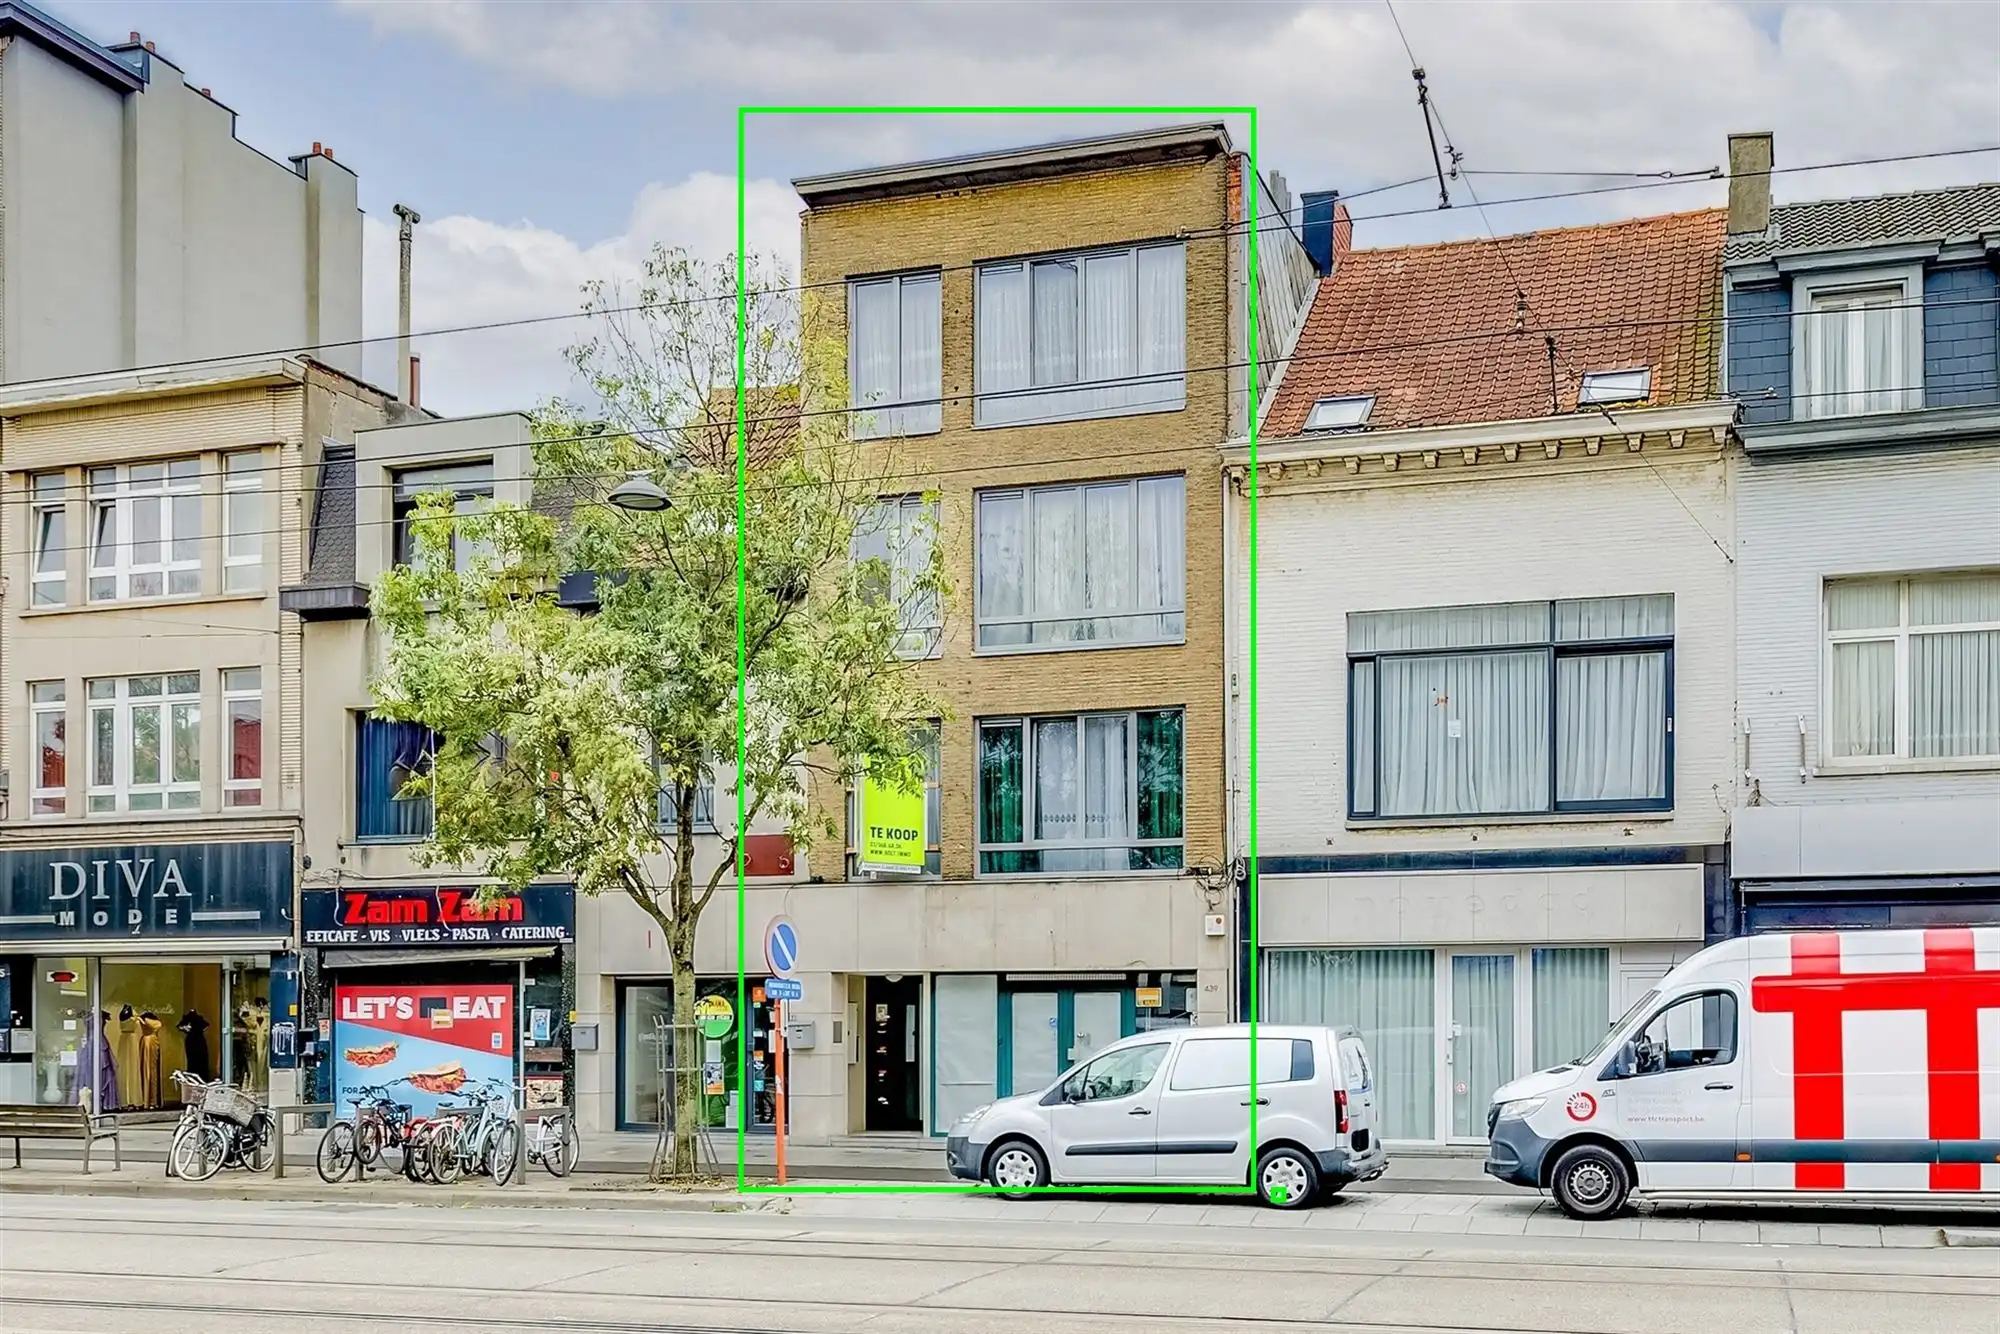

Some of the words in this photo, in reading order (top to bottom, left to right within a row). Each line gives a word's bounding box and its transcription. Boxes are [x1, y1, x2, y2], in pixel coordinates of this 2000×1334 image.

[870, 826, 883, 838] TE
[886, 828, 918, 841] KOOP
[49, 858, 192, 900] DIVA
[344, 892, 428, 923] Zam
[436, 891, 524, 922] Zam
[58, 908, 178, 927] MODE
[306, 930, 358, 942] EETCAFE
[369, 929, 391, 941] VIS
[452, 928, 490, 940] PASTA
[501, 926, 565, 939] CATERING
[342, 997, 413, 1020] LET'S
[453, 996, 506, 1019] EAT
[1574, 1101, 1590, 1109] 24h
